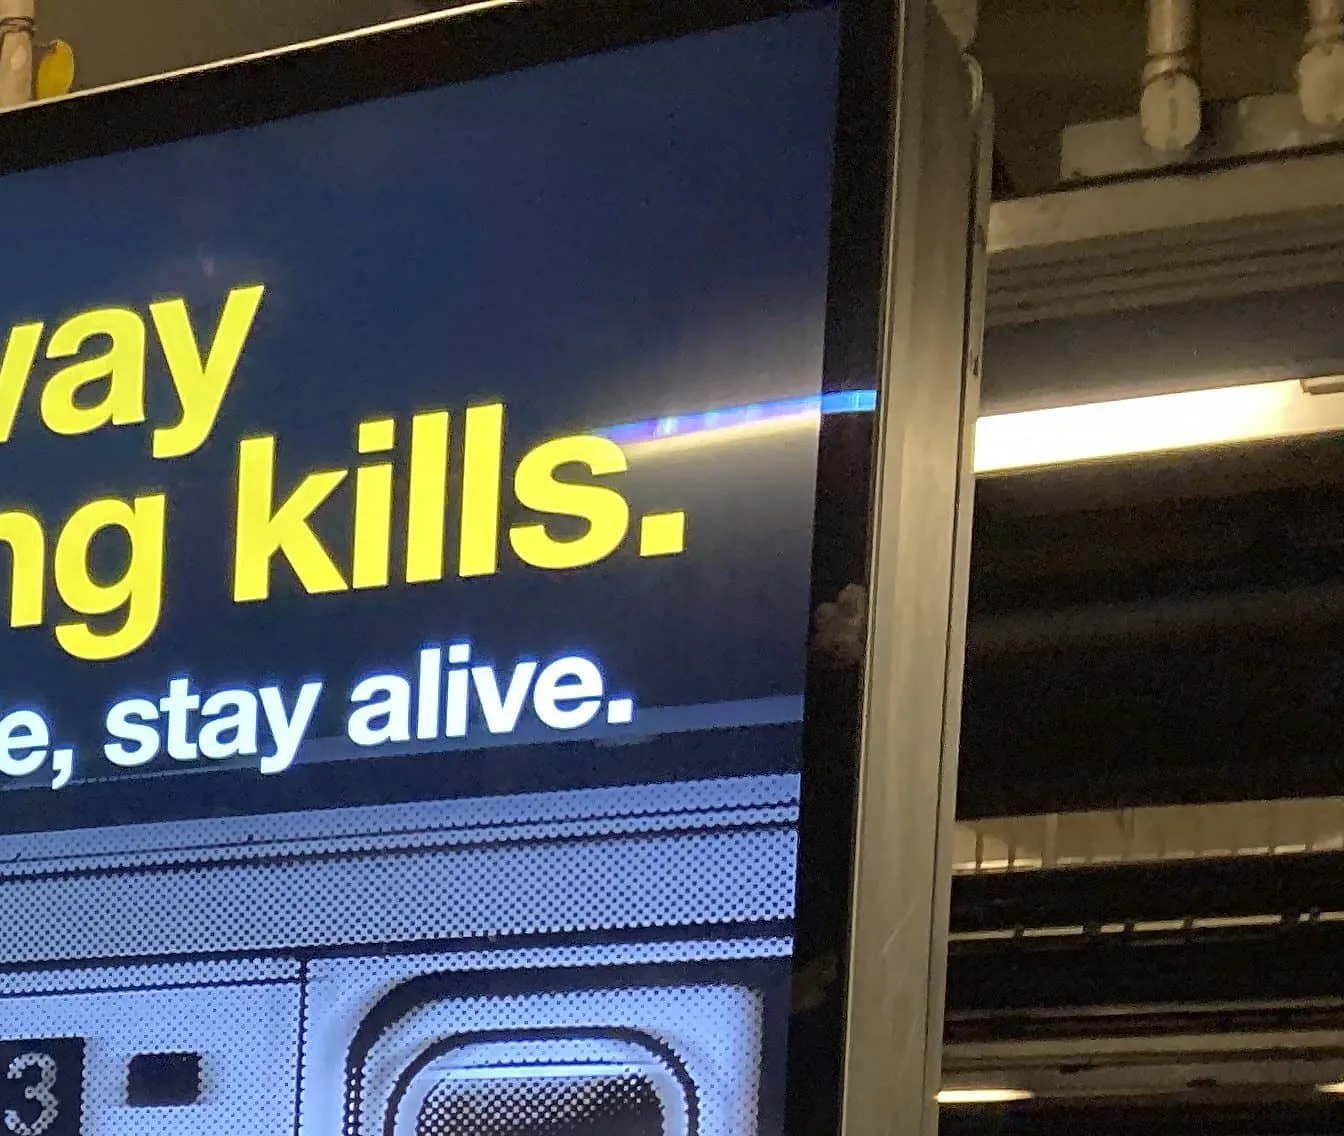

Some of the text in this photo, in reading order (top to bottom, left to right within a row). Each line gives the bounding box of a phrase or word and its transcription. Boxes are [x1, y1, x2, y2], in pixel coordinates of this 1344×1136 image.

[234, 402, 684, 602] kills.
[104, 673, 321, 773] stay
[348, 643, 632, 746] alive.
